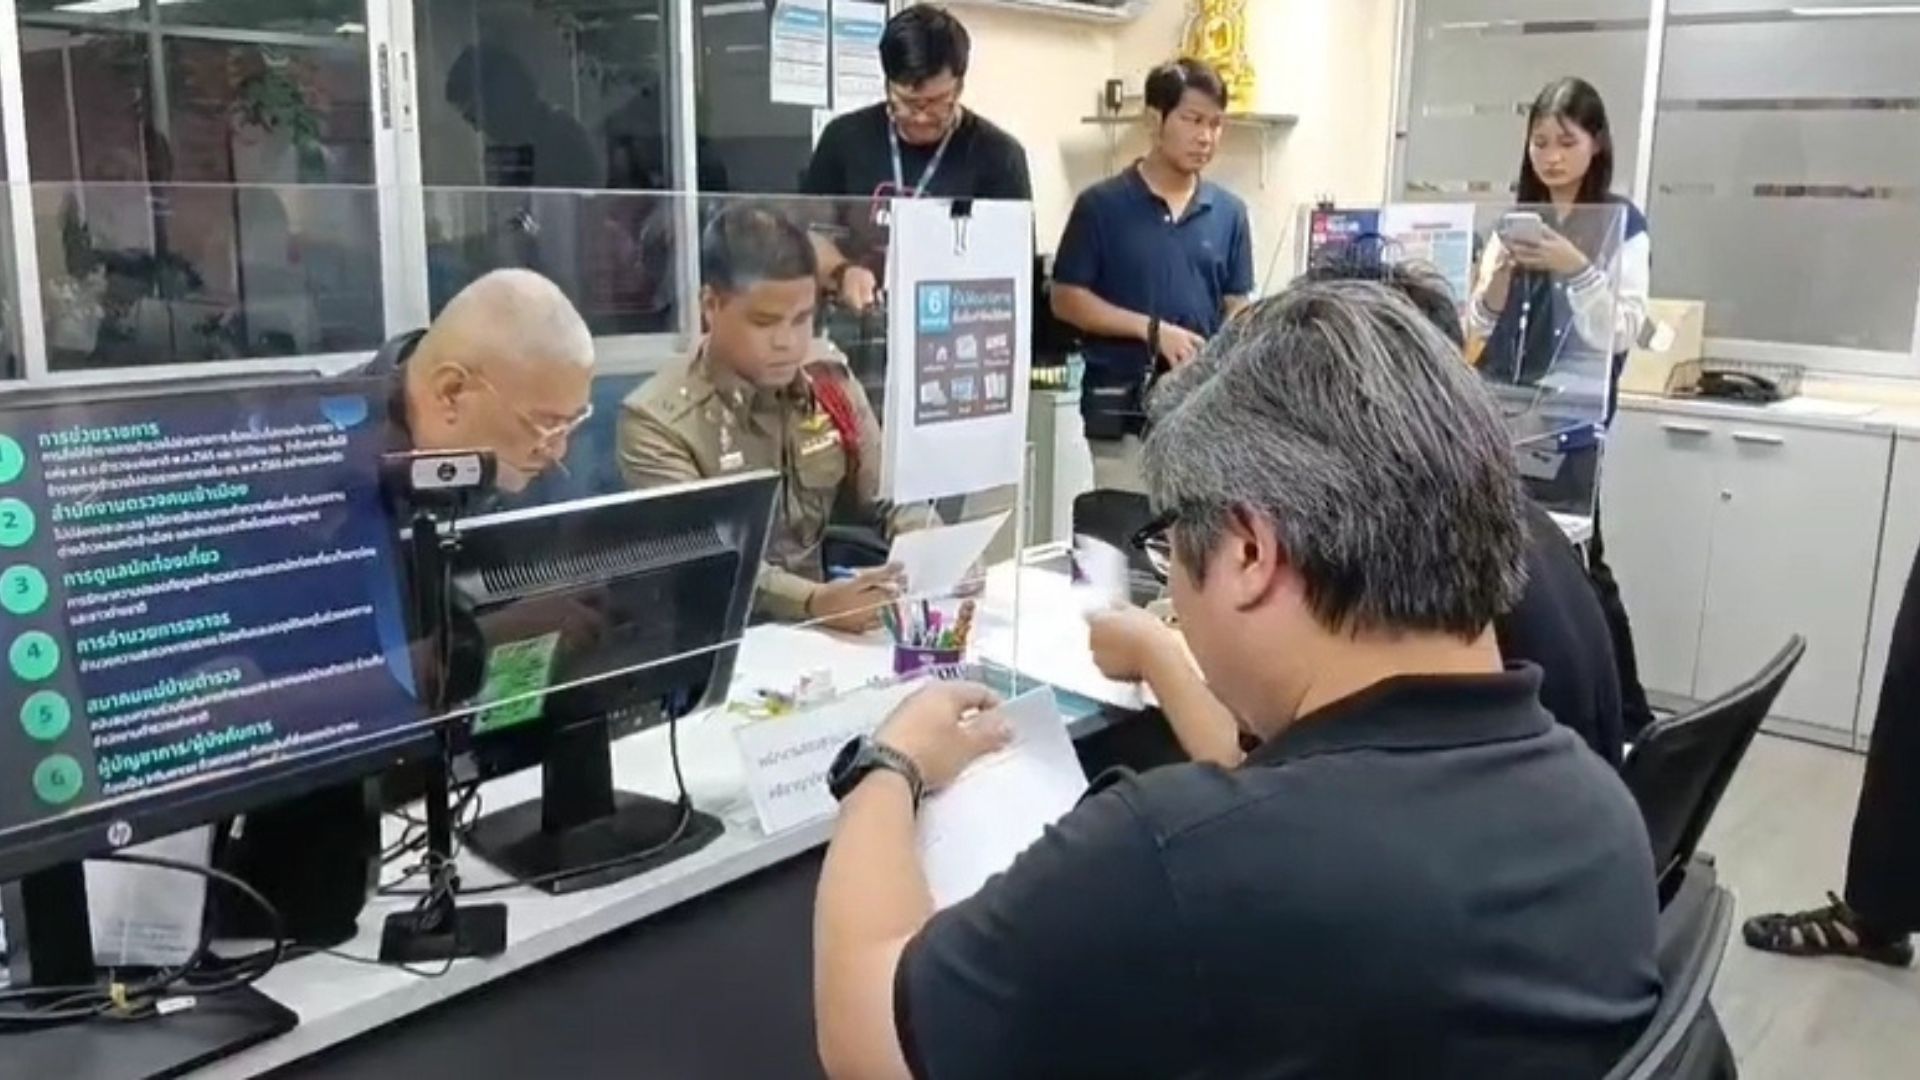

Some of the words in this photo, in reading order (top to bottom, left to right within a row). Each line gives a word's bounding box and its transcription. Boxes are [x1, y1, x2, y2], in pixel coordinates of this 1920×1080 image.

[928, 290, 943, 315] 6
[39, 422, 160, 446] การช่วยราชการ
[52, 482, 249, 521] สำนักงานตรวจคนเข้าเมือง
[3, 510, 19, 528] 2
[63, 545, 220, 587] การดูแลนักท่องเที่ยว
[15, 576, 29, 594] 3
[78, 612, 230, 654] การอำนวยการจราจร
[26, 643, 41, 659] 4
[88, 667, 241, 713] สมาคมแม่บ้านตำรวจ
[39, 706, 53, 723] 5
[100, 720, 273, 778] ผู้บัญชาการ/ผู้บังคับการ
[51, 770, 65, 788] 6
